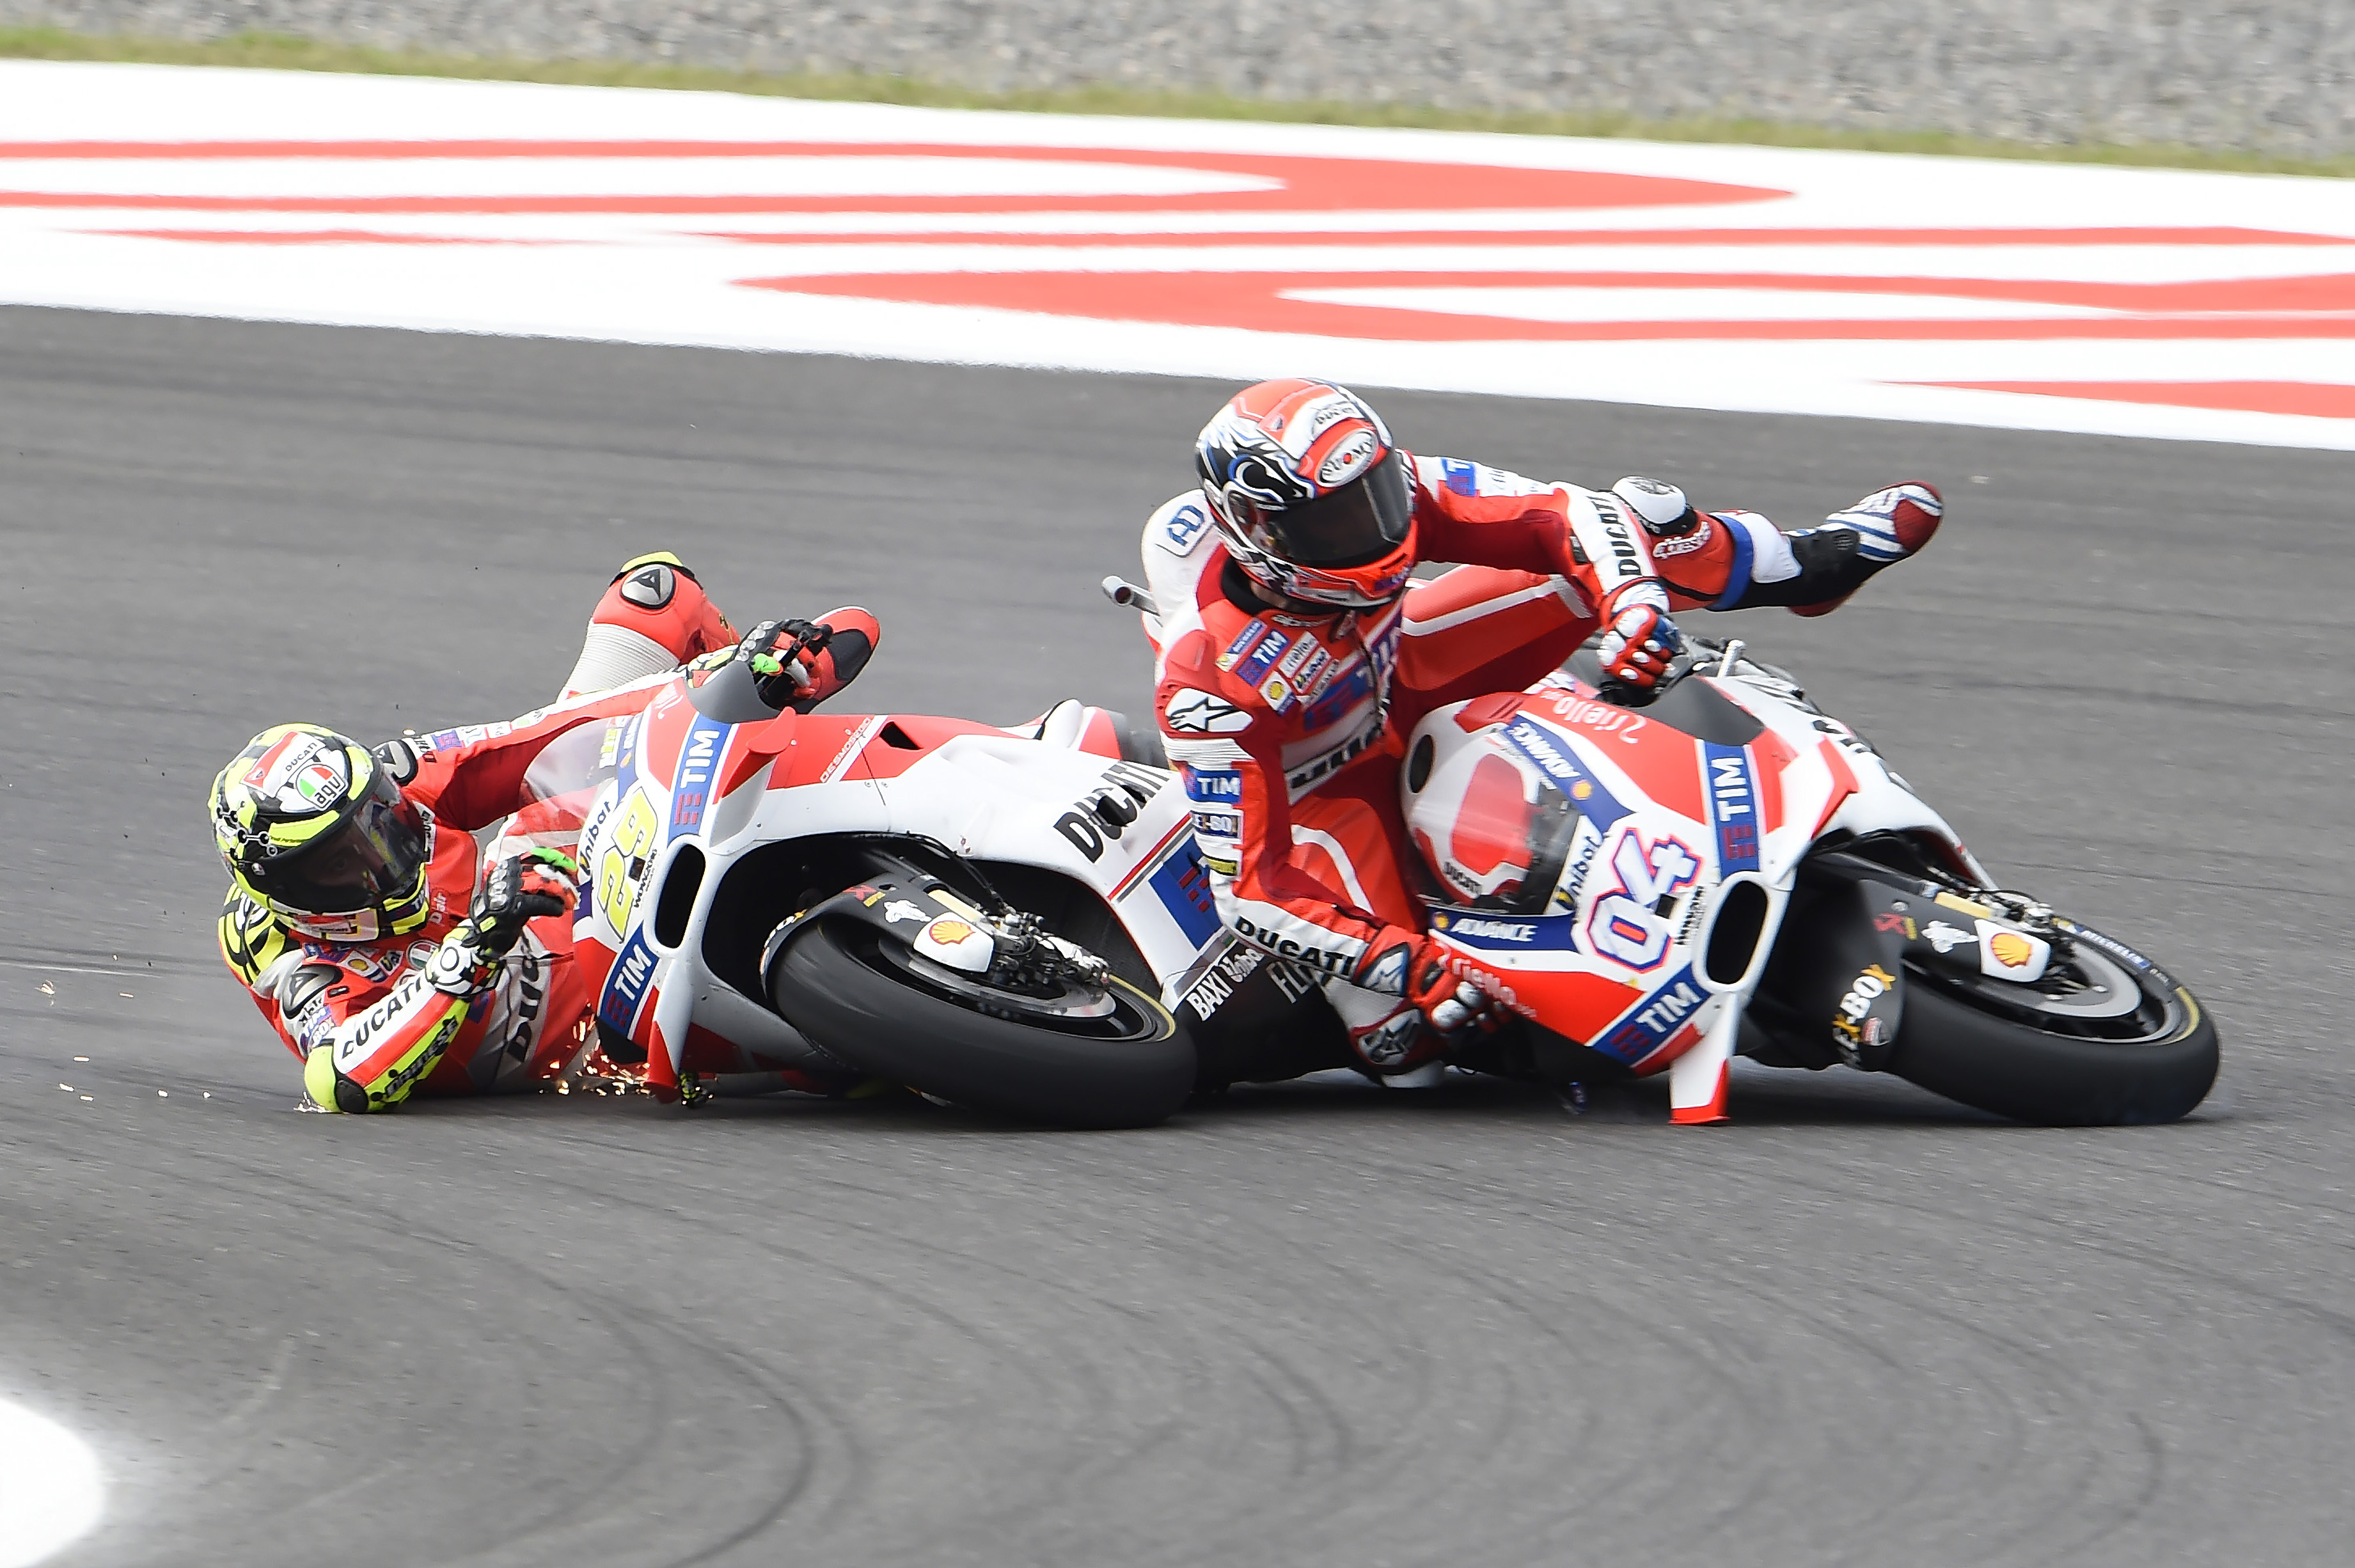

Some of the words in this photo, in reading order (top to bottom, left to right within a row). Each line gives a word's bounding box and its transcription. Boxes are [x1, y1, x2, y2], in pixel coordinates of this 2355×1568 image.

[1586, 495, 1642, 576] DUCATI
[1252, 631, 1288, 664] TIM
[285, 742, 319, 772] DUCATI
[680, 730, 720, 788] TIM
[1507, 723, 1582, 778] ADVANCE
[314, 776, 341, 804] agv
[1053, 760, 1170, 864] DUCATI
[1197, 776, 1240, 796] TIM
[1710, 757, 1750, 822] TIM
[597, 785, 658, 944] 29
[1587, 826, 1705, 975] 04
[1235, 916, 1356, 976] DUCATI
[1450, 918, 1539, 942] ADVANCE
[614, 943, 652, 1001] TIM
[1186, 971, 1234, 1021] BAXI
[341, 976, 421, 1060] DUCATI
[1637, 982, 1702, 1033] TIM
